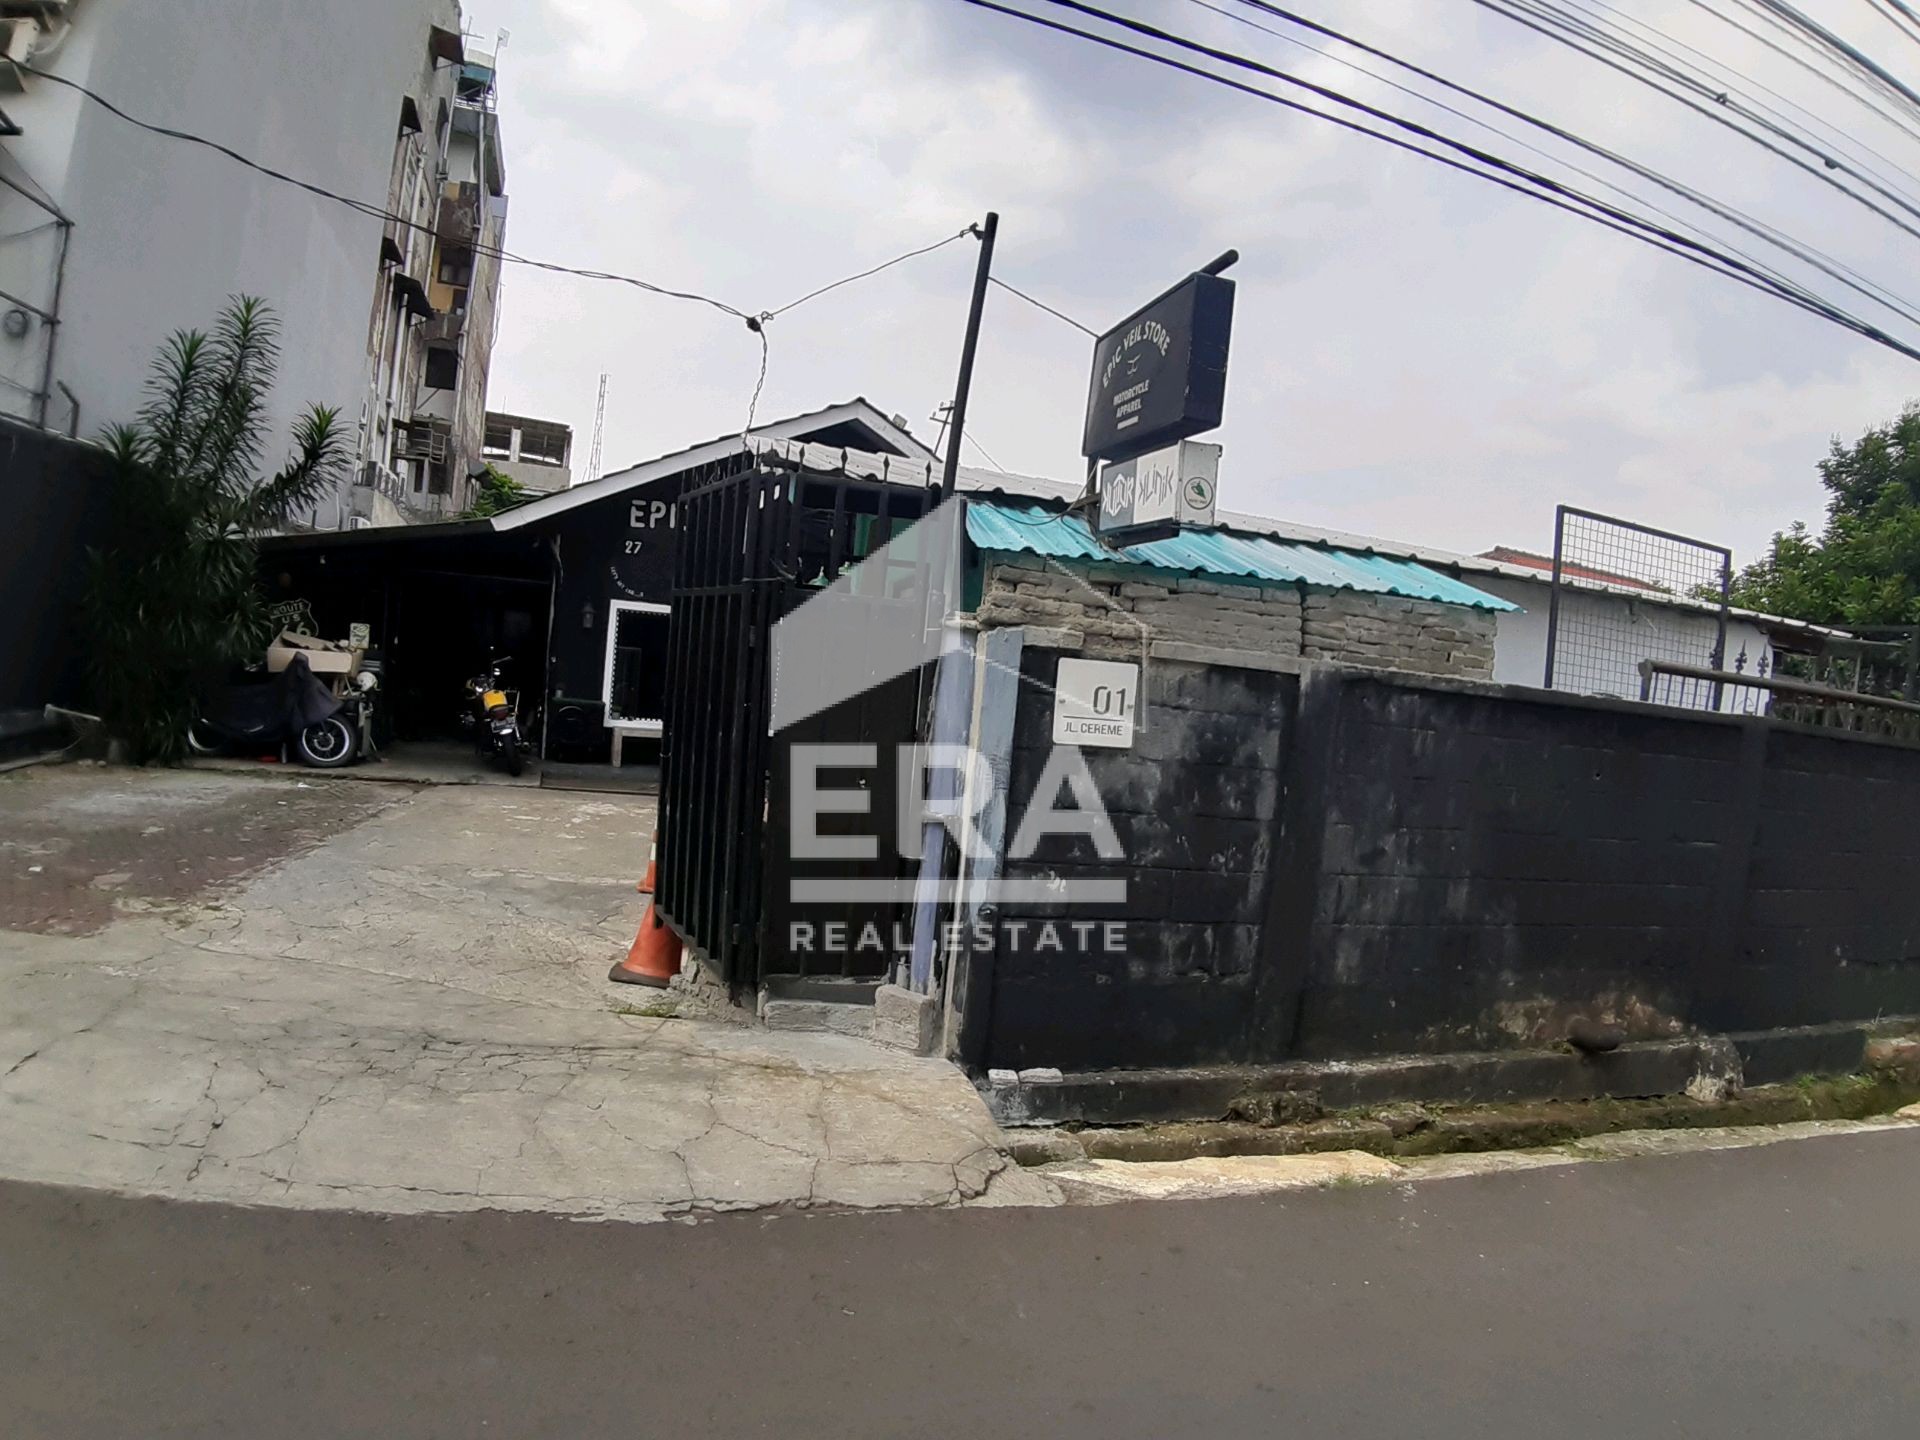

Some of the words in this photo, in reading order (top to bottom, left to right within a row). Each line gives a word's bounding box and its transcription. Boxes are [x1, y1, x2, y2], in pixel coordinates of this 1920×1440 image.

[1103, 345, 1121, 388] EPIC
[1123, 325, 1141, 351] VEIL
[1143, 321, 1170, 356] STORE
[1113, 380, 1149, 405] MOTORCYCLE
[1116, 399, 1141, 418] APPAREL
[630, 500, 688, 530] EPI
[625, 541, 642, 554] 27
[1093, 686, 1126, 716] 01
[1080, 723, 1123, 735] CEREME
